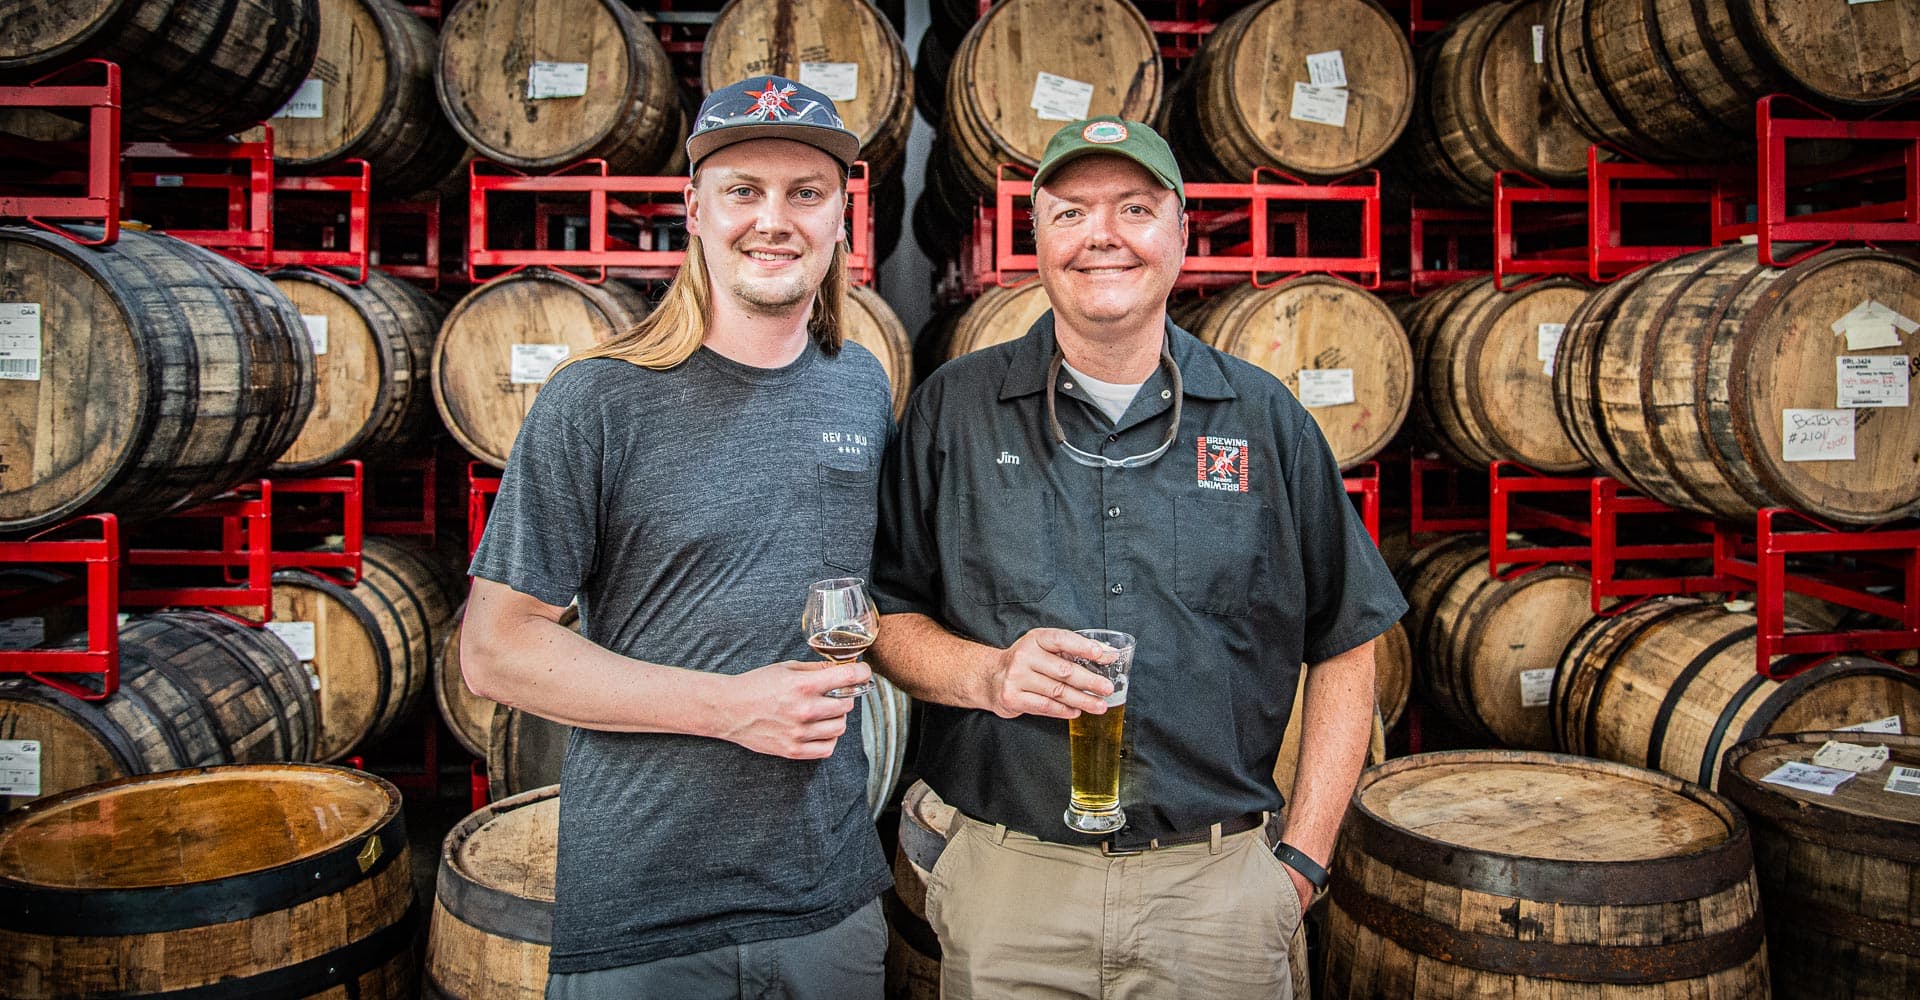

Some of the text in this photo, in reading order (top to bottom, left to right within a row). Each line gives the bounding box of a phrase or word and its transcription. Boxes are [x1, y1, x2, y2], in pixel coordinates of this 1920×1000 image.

[822, 431, 841, 443] REV
[1206, 436, 1248, 447] BREWING
[996, 451, 1020, 465] Jim
[1197, 436, 1207, 481] REVOLUTION
[1239, 446, 1249, 493] REVOLUTION
[1197, 480, 1239, 492] BREWING
